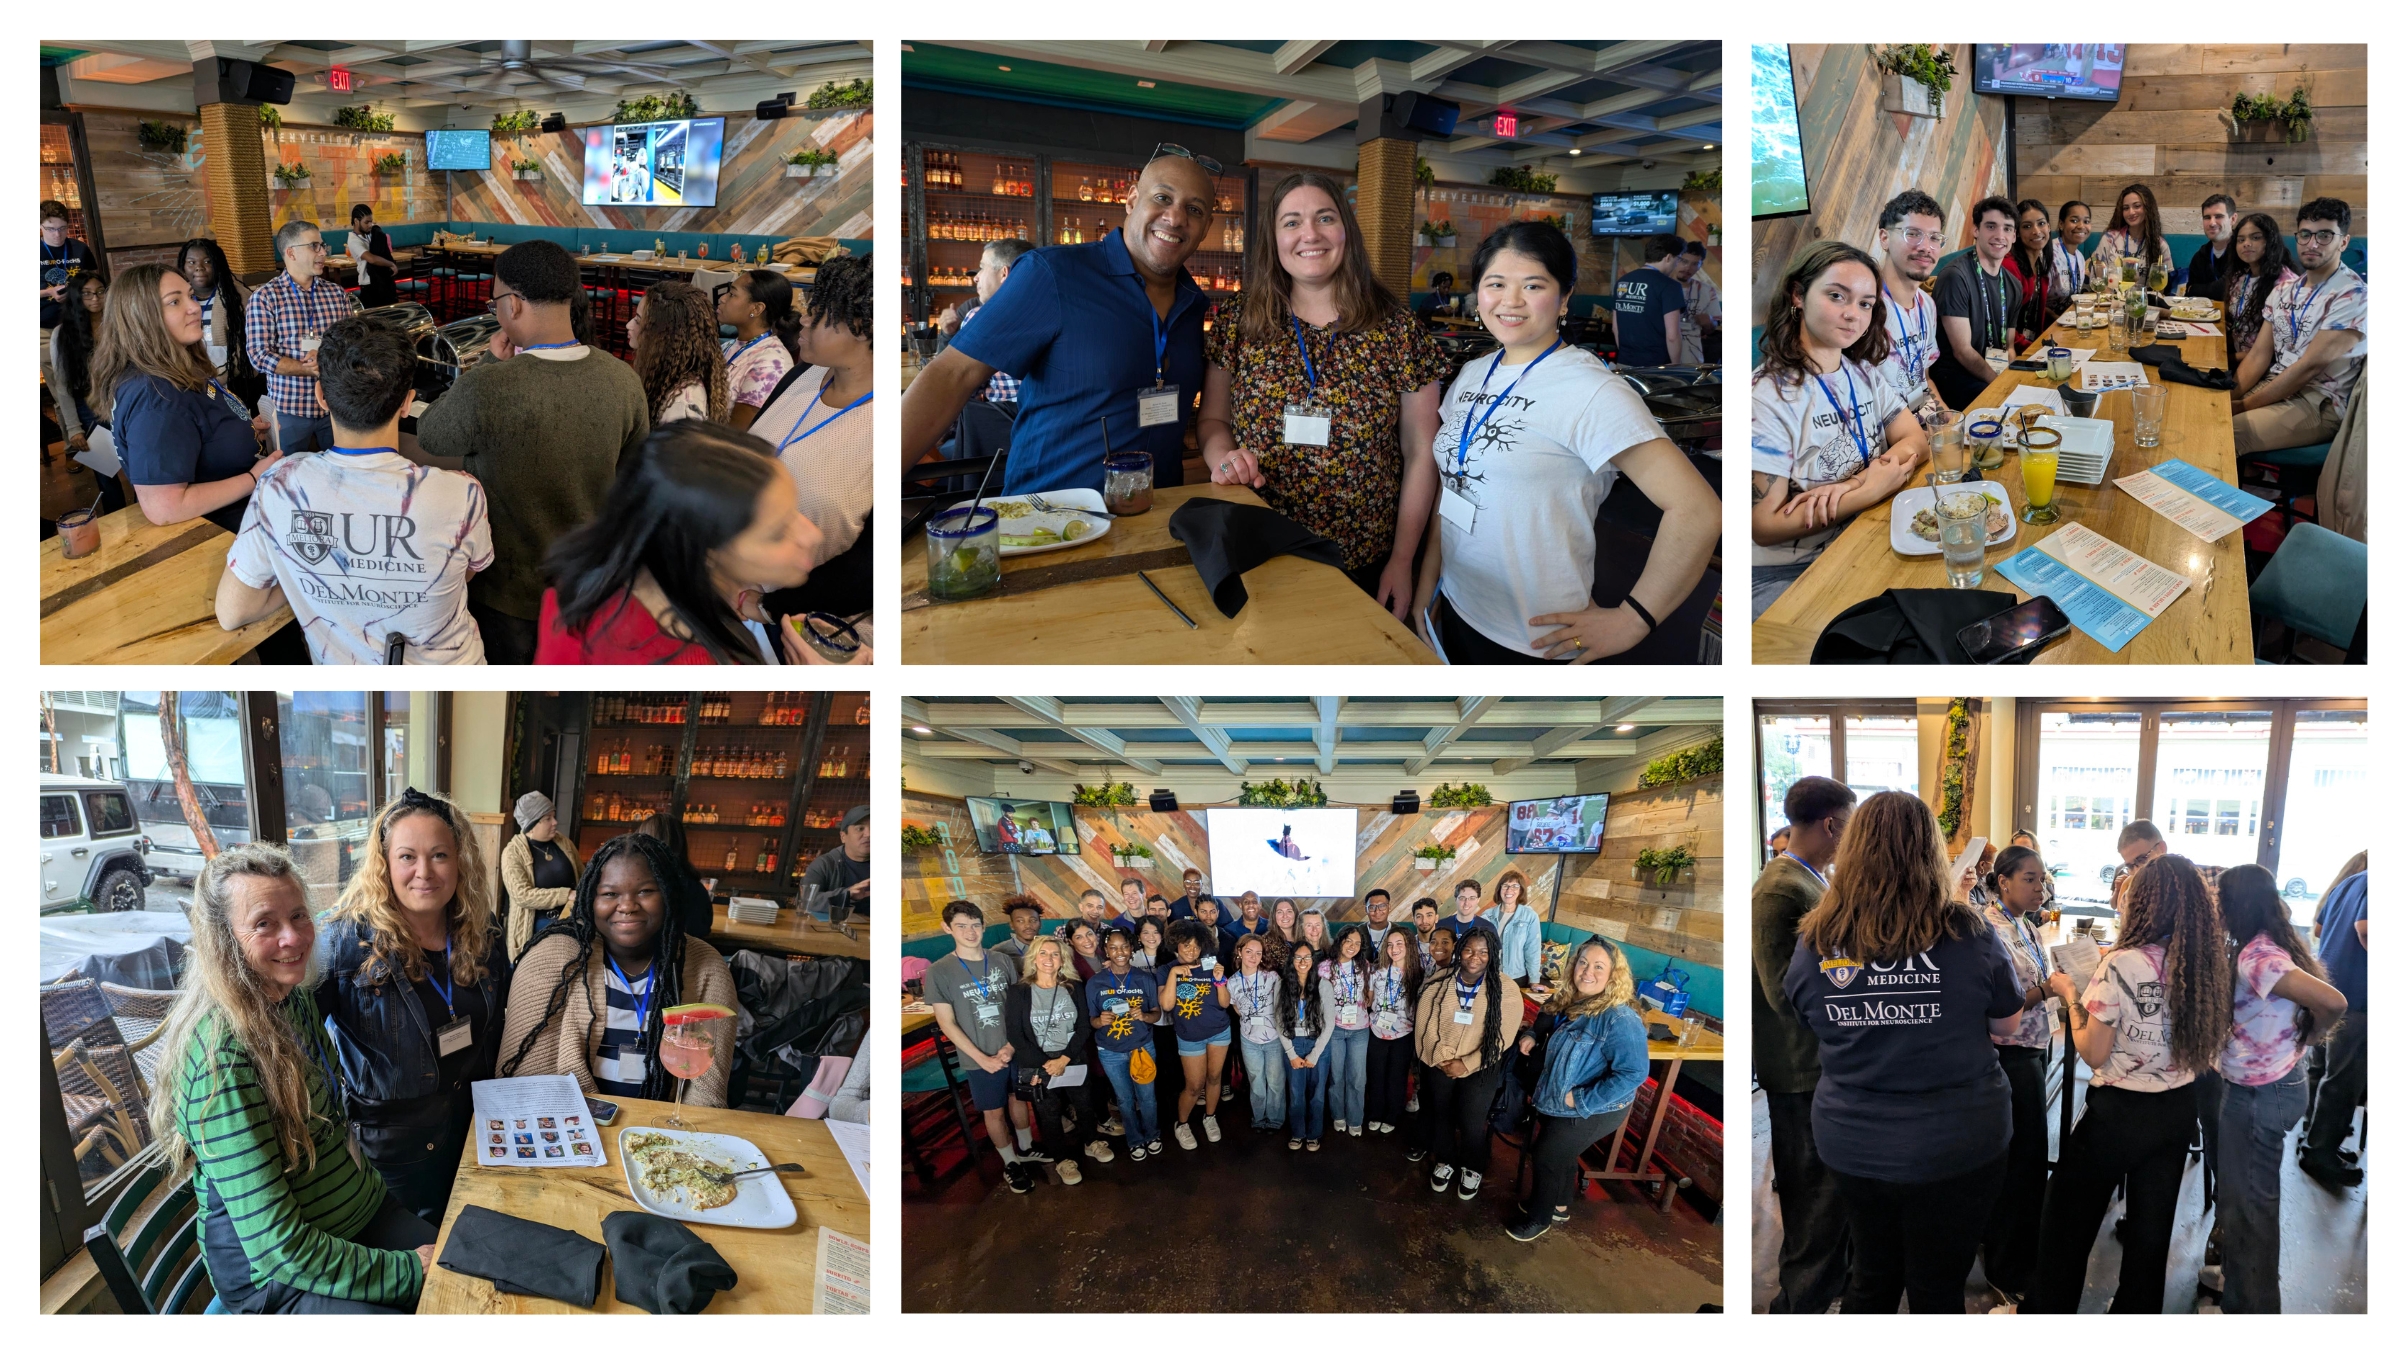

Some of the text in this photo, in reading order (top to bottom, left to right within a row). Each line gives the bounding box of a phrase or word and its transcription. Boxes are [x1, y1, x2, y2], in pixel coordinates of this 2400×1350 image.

[332, 70, 350, 91] EXIT
[1497, 116, 1516, 137] EXIT
[1628, 282, 1648, 296] UR
[1812, 401, 1874, 429] NEUOCIT
[291, 534, 332, 545] MELIORA
[340, 512, 425, 561] UR
[342, 558, 427, 574] MEDICINE
[340, 582, 429, 604] MONTE
[361, 601, 419, 610] NEUROSCIENCE
[936, 821, 967, 900] ROO
[1867, 973, 1941, 986] MEDICINE
[1825, 1000, 1942, 1022] DEL MONTE
[1881, 1018, 1932, 1026] NEUROSCIENCE
[2127, 1024, 2155, 1042] DEL
[825, 1284, 849, 1298] TORTAS
